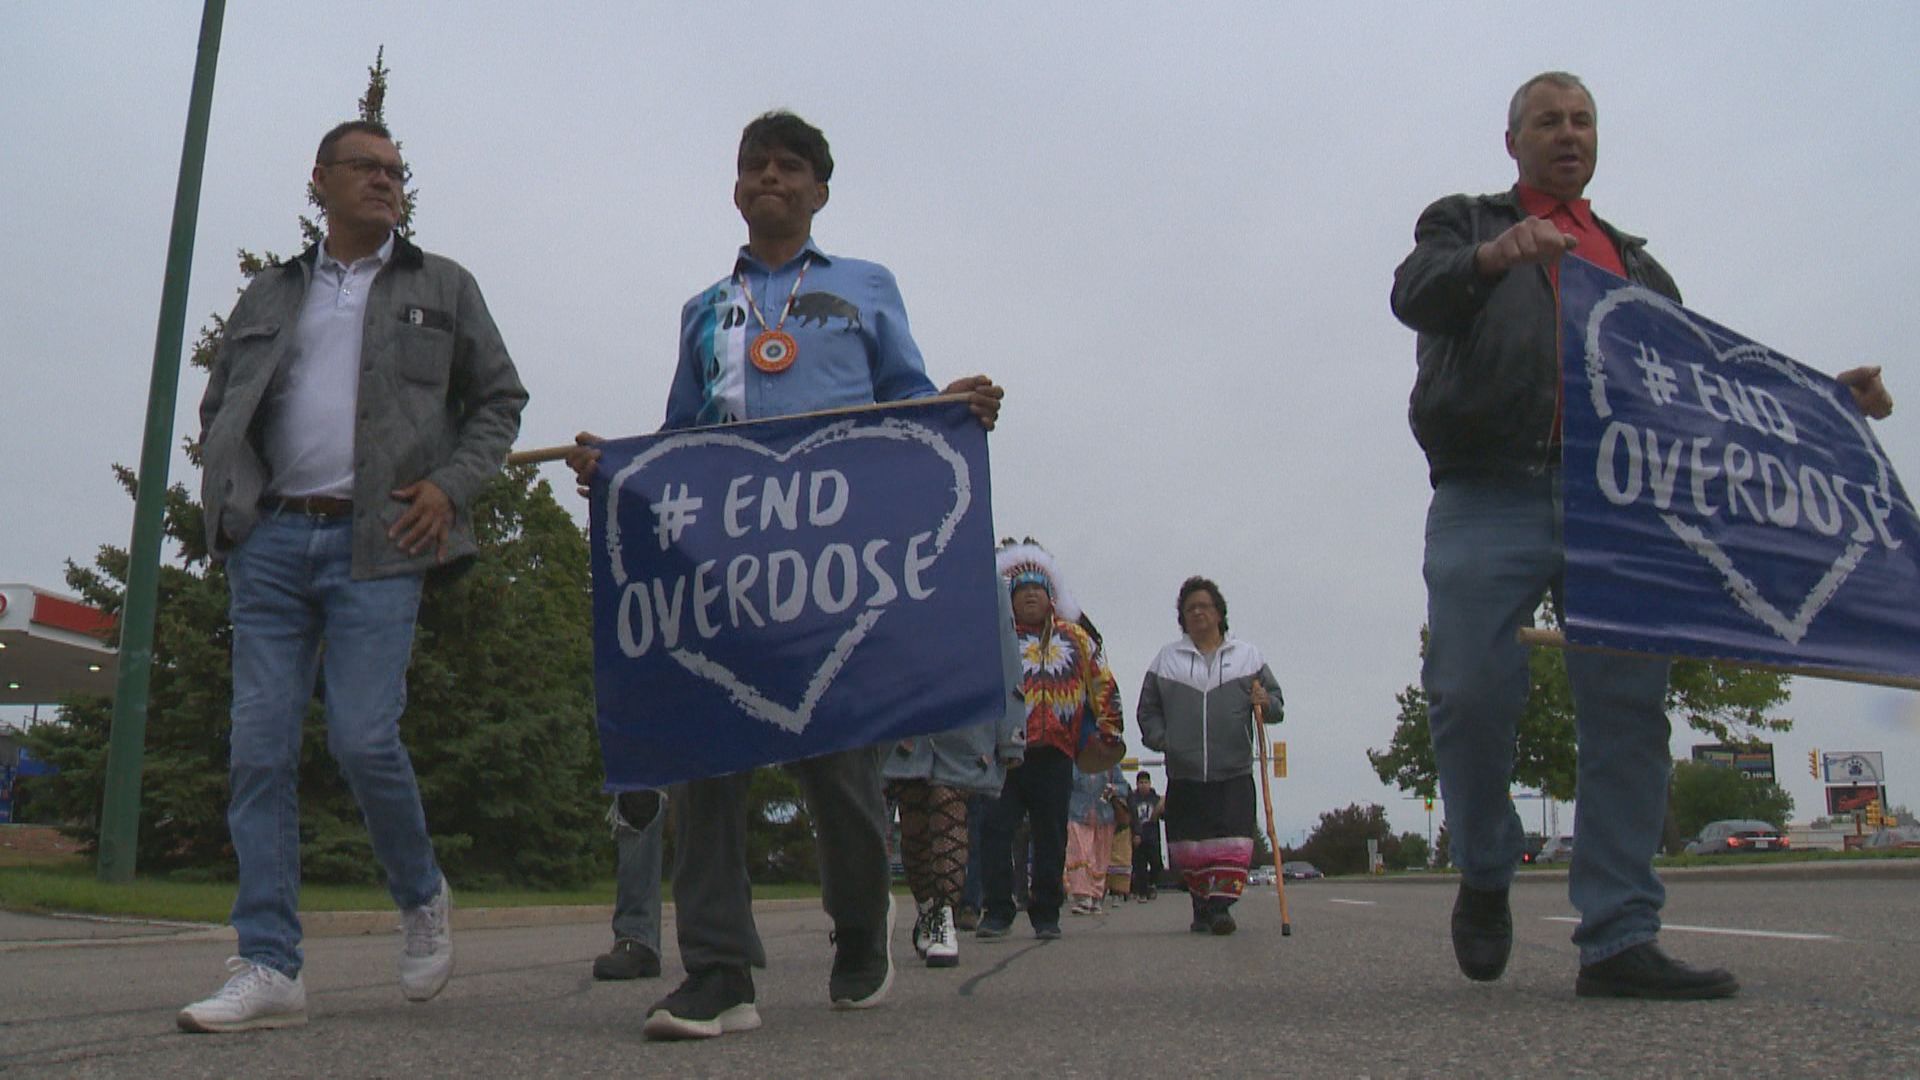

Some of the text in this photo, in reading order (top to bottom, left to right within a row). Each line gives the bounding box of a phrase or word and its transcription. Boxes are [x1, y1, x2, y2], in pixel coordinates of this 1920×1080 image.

[1636, 342, 1797, 443] # END
[651, 470, 849, 550] # END
[1597, 421, 1902, 549] OVERDOSE
[618, 531, 937, 658] OVERDOSE
